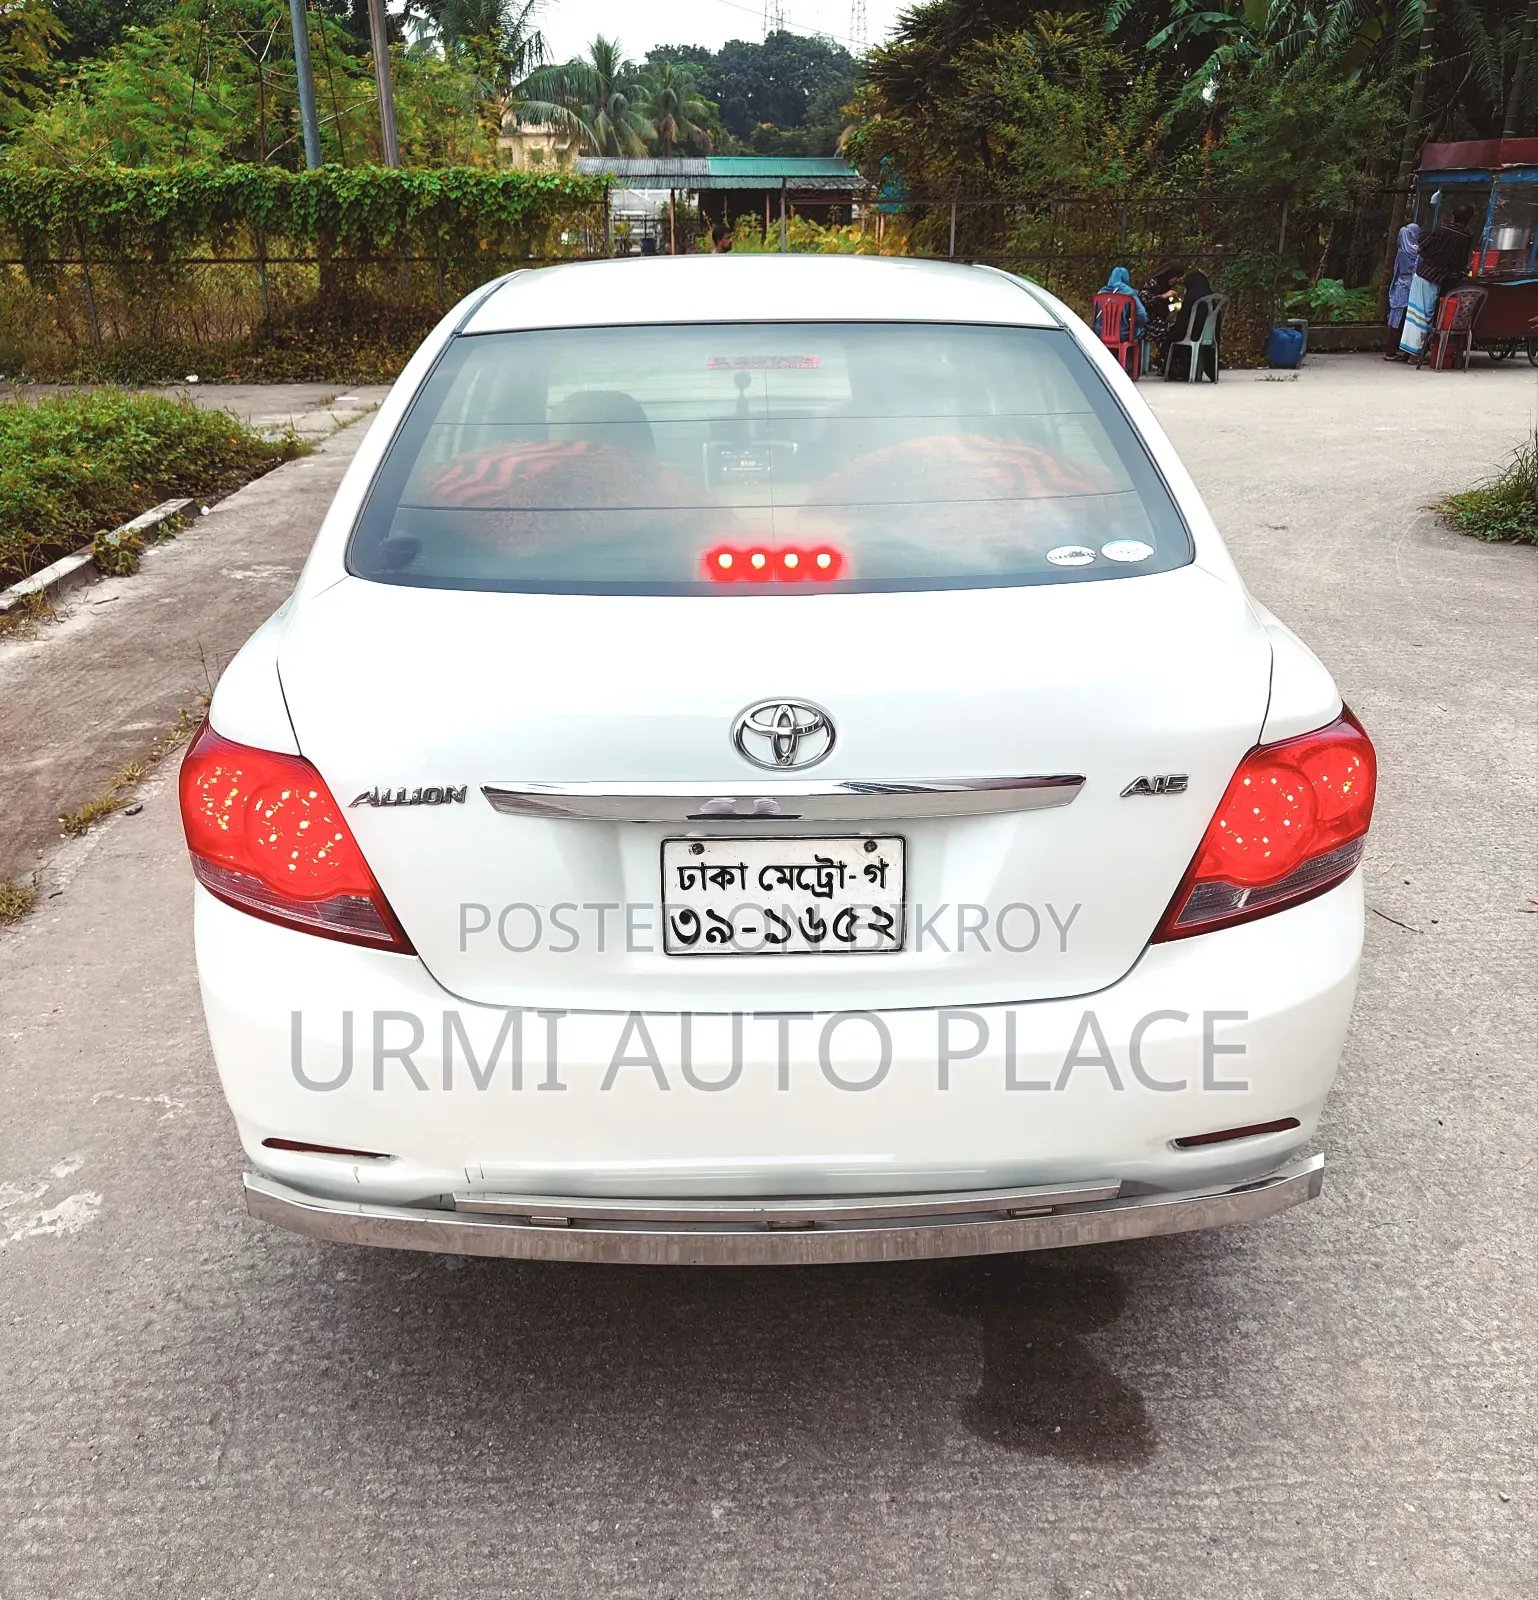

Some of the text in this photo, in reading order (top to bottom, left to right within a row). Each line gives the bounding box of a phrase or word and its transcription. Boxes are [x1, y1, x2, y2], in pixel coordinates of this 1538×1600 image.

[347, 785, 468, 808] ALLION
[1119, 773, 1190, 798] A15
[676, 862, 749, 891] ঢাকা
[670, 906, 897, 945] ৩৯-১৬৫২
